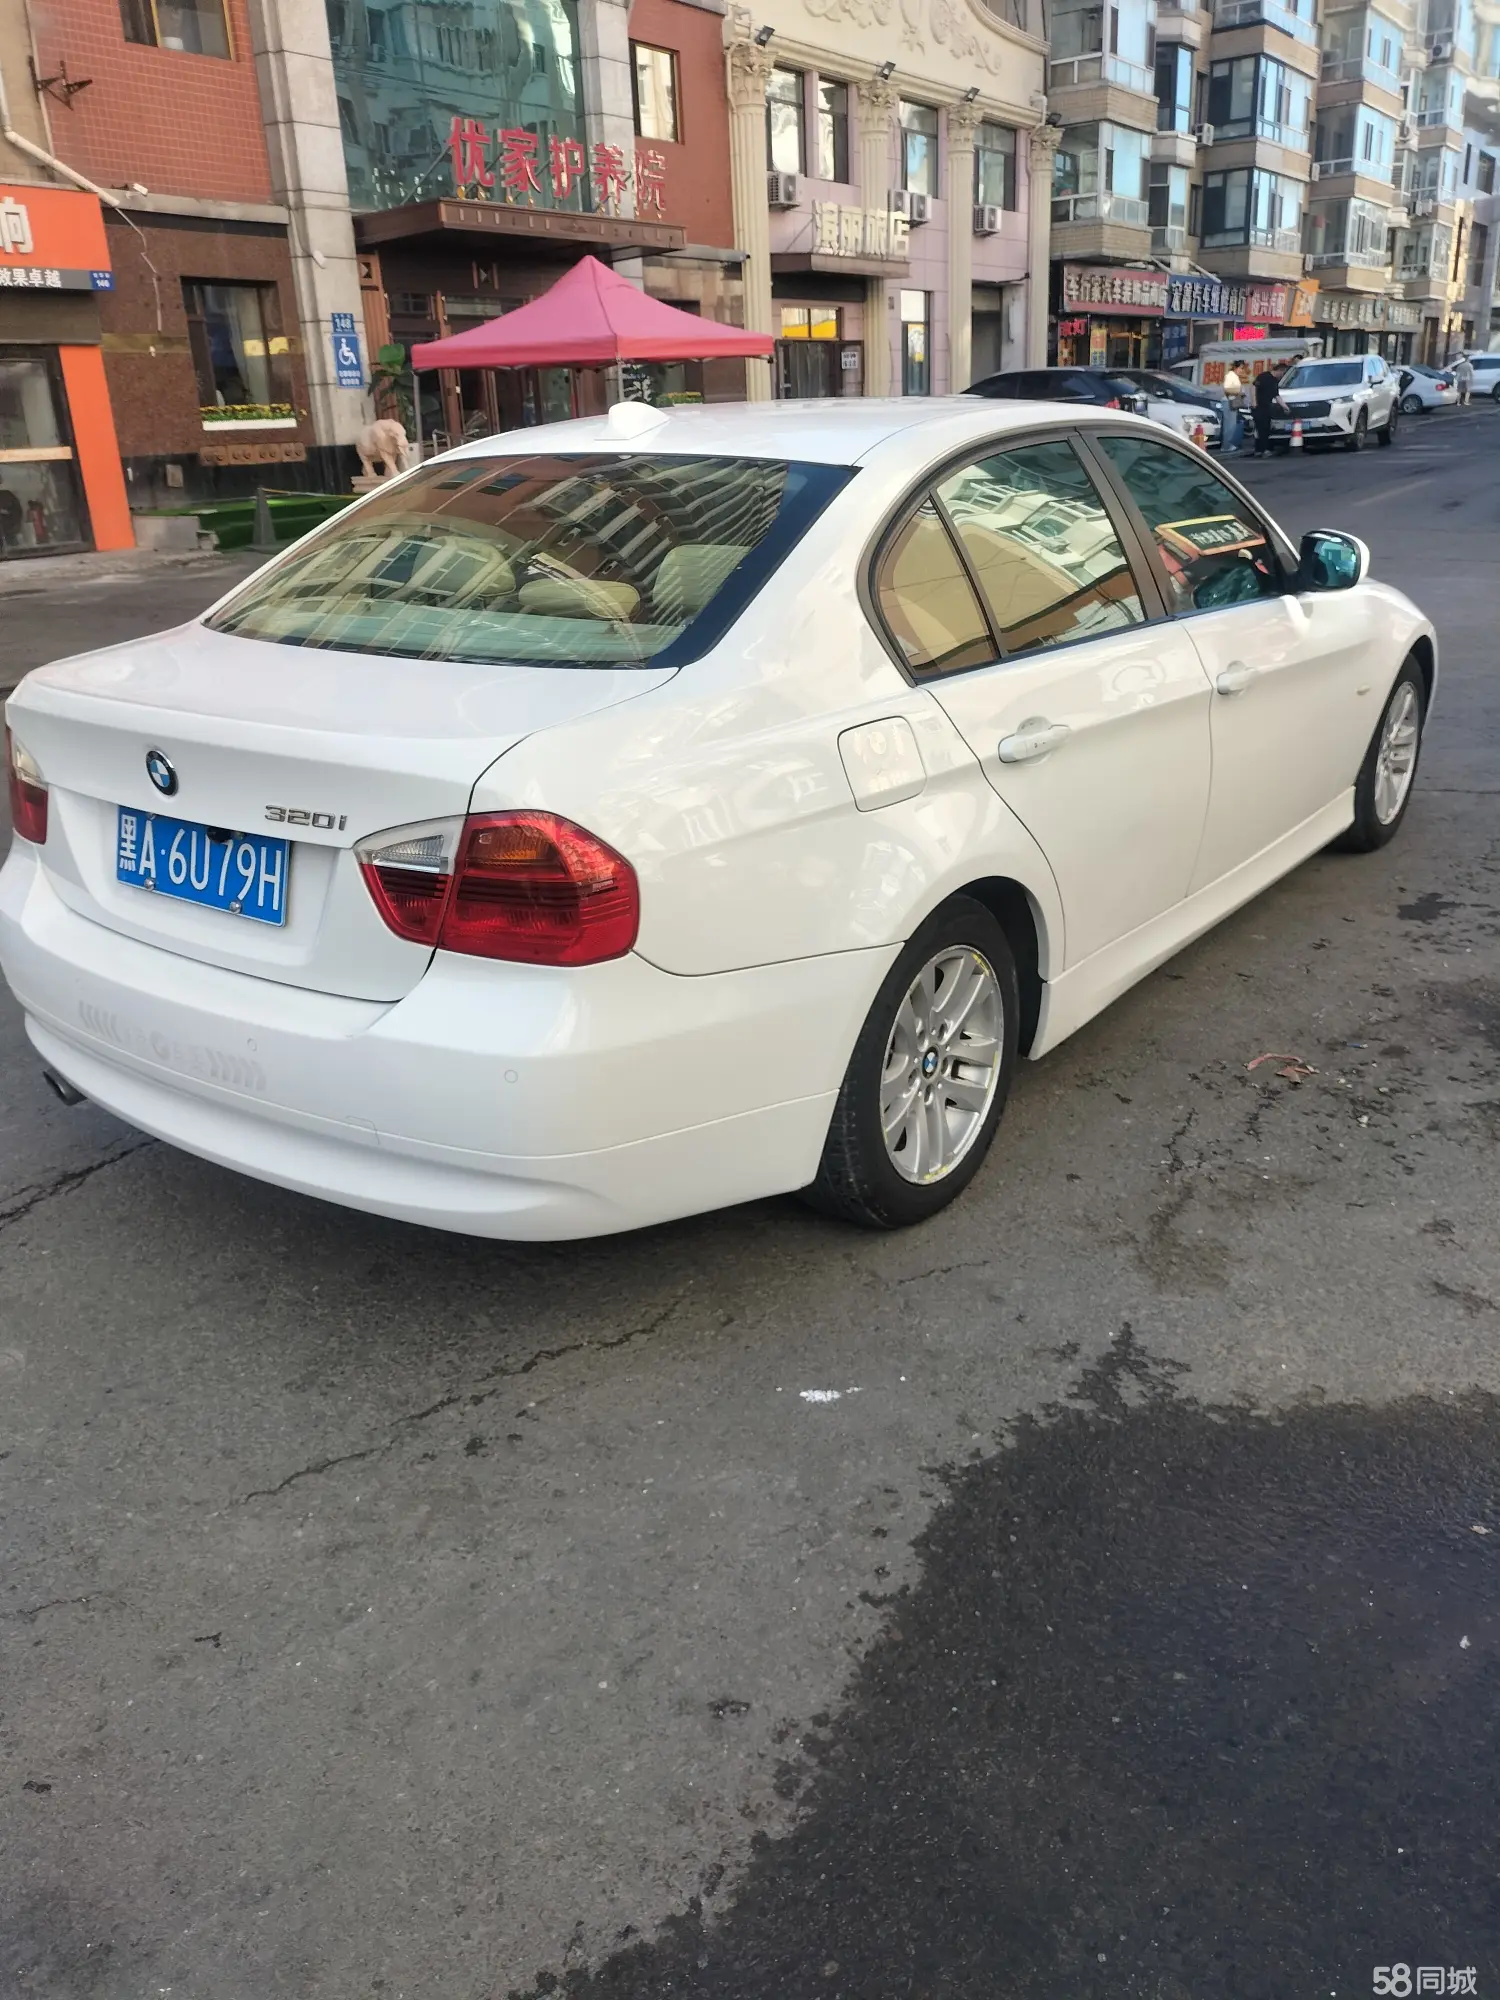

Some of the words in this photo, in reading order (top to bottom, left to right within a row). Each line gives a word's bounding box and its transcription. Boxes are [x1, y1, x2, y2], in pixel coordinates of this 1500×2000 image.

[445, 116, 667, 211] 优家护养院
[265, 804, 348, 831] 320i
